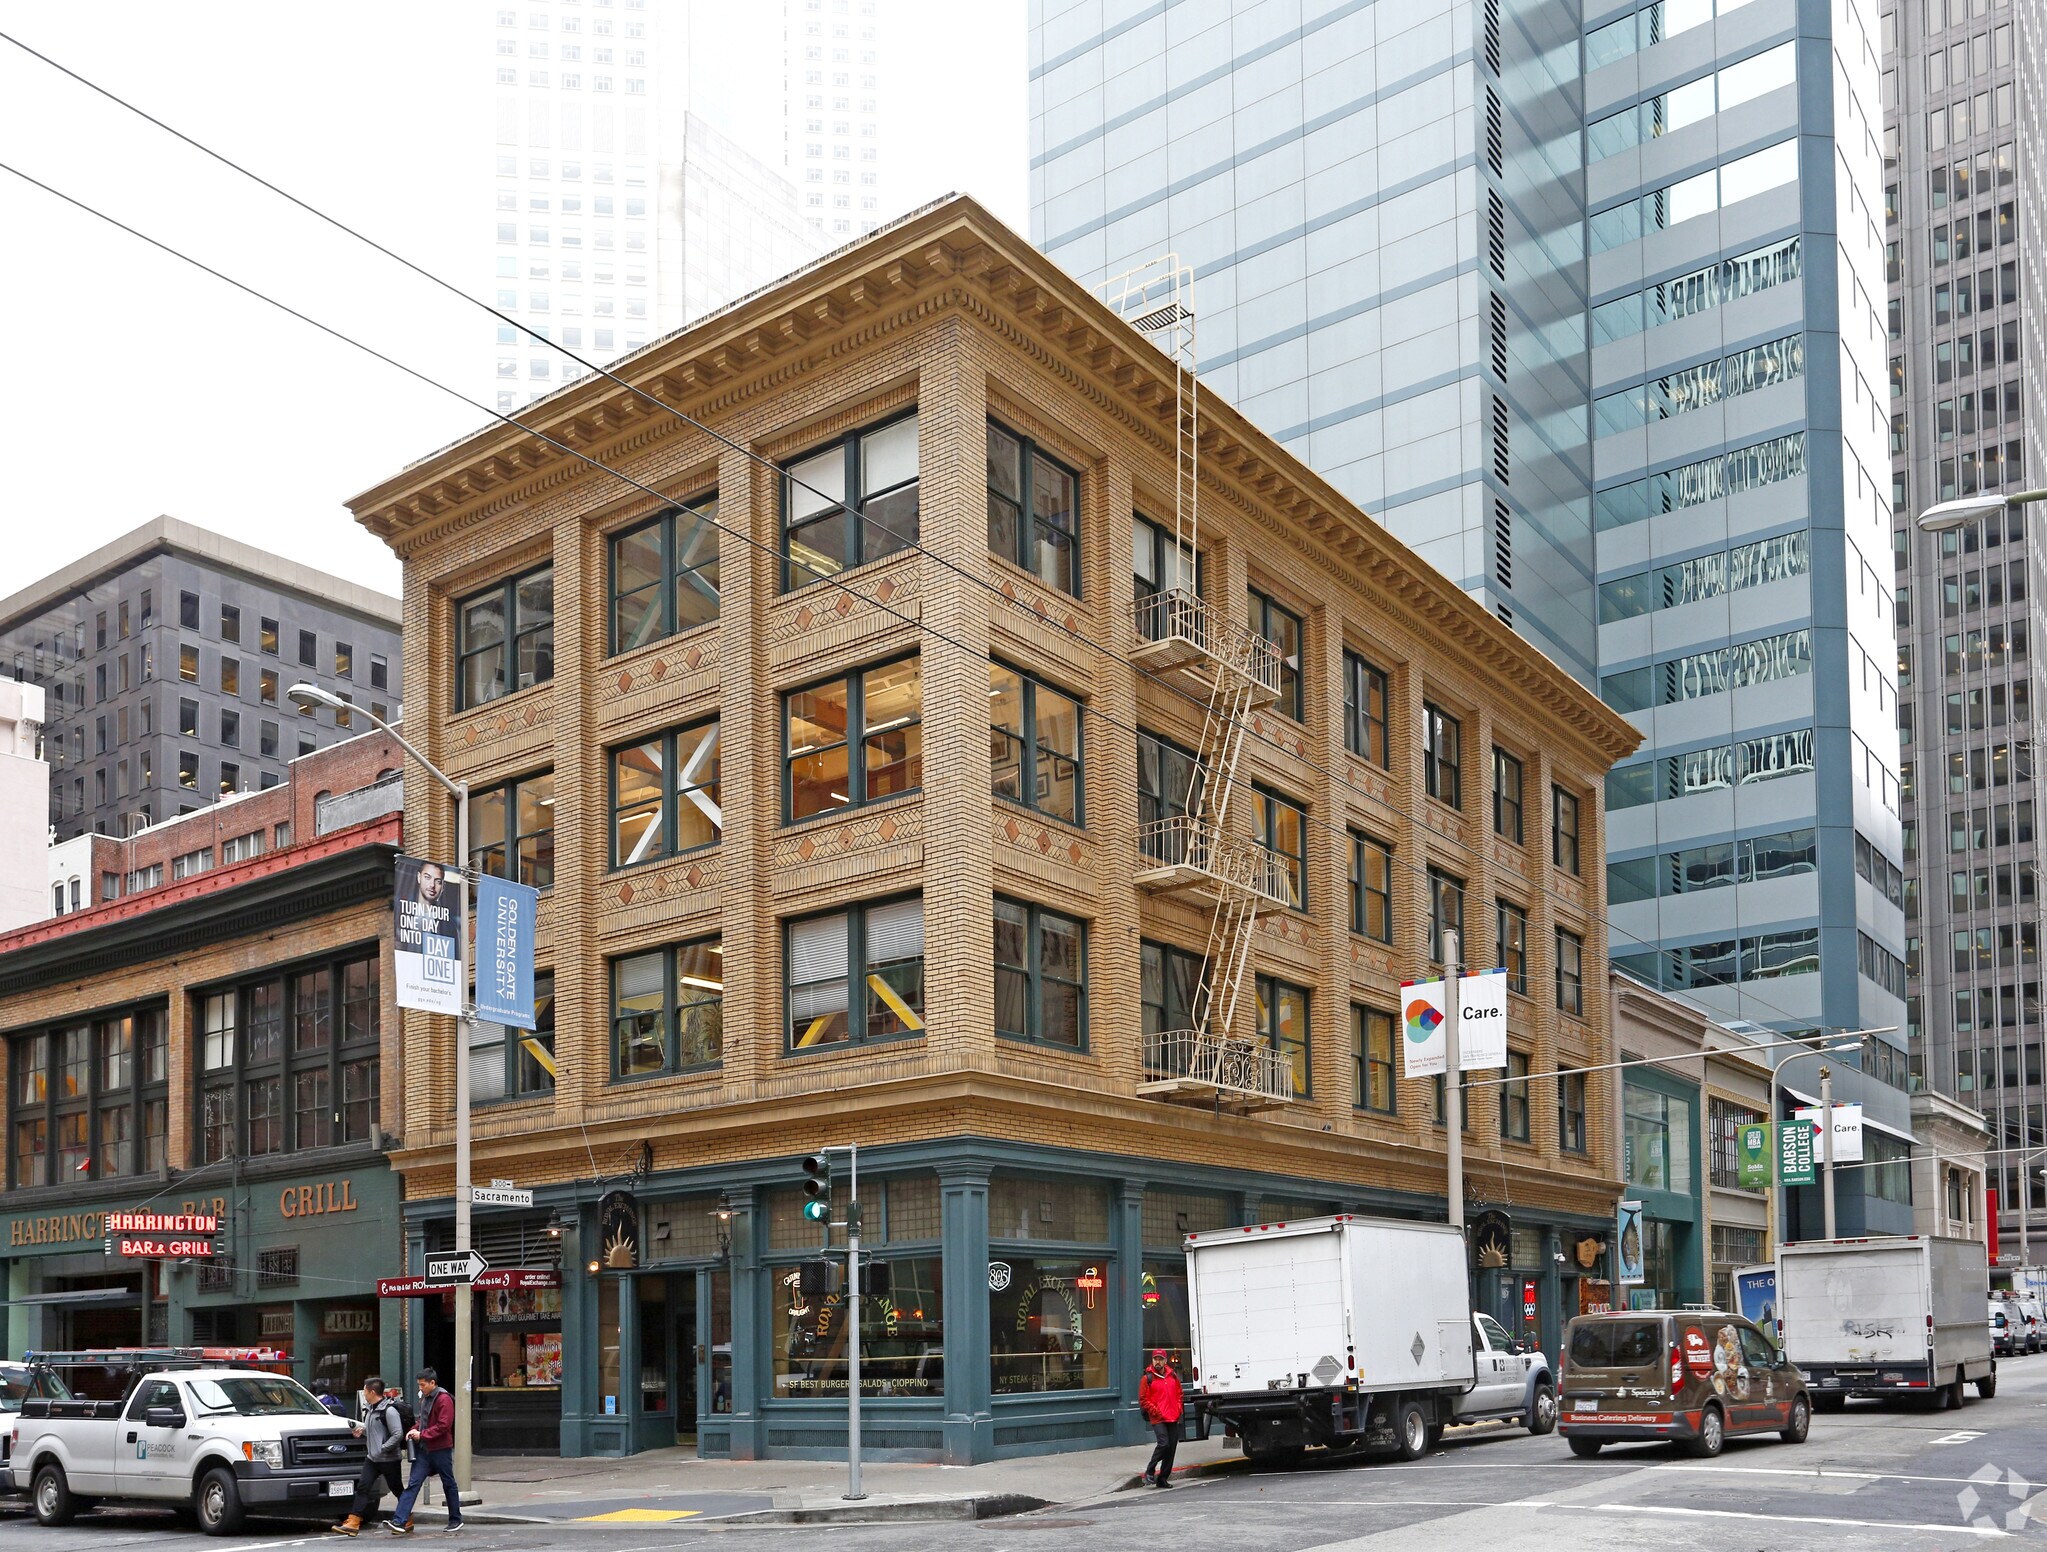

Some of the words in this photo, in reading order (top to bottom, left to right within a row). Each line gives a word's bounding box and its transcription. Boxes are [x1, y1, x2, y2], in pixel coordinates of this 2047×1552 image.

[400, 899, 426, 917] TURN
[426, 903, 450, 922] YOUR
[400, 914, 419, 931] ONE
[422, 917, 440, 934] DAY
[507, 898, 518, 959] GOLDEN
[400, 930, 422, 945] INTO
[426, 936, 450, 958] DAY
[496, 896, 508, 999] UNIVERSITY
[427, 958, 451, 979] ONE
[406, 982, 420, 991] Finish
[420, 986, 430, 994] your
[506, 961, 516, 1001] GATE
[1463, 1006, 1503, 1020] Care.
[1409, 1056, 1423, 1064] Newly
[1423, 1053, 1445, 1062] Expanded
[1409, 1063, 1421, 1071] Open
[1834, 1124, 1860, 1133] Care.
[1747, 1138, 1761, 1146] MBA
[1798, 1125, 1811, 1172] COLLEGE
[1783, 1126, 1797, 1174] BABSON
[494, 1180, 507, 1188] 300
[280, 1179, 358, 1218] GRILL
[474, 1190, 530, 1203] Sacramento
[109, 1213, 217, 1232] HARRINGTON
[121, 1240, 158, 1255] BAR
[157, 1242, 166, 1254] &
[168, 1240, 212, 1255] GRILL
[430, 1263, 448, 1275] ONE
[450, 1261, 469, 1274] WAY
[519, 1279, 557, 1287] RoyalExchange.com
[989, 1268, 1009, 1284] 805
[1747, 1279, 1765, 1289] THE
[1767, 1278, 1775, 1287] O
[788, 1304, 811, 1317] DRAUGHT
[1016, 1283, 1038, 1332] ROYAL
[334, 1312, 364, 1330] PUB
[488, 1314, 502, 1323] FRESH
[517, 1312, 539, 1322] GOURMET
[539, 1311, 550, 1320] TAKE
[550, 1311, 561, 1320] AWA
[527, 1341, 559, 1353] sandwich
[788, 1380, 799, 1389] SF
[800, 1380, 819, 1389] BEST
[891, 1378, 929, 1388] CIOPPINO
[999, 1375, 1008, 1385] NY
[1009, 1374, 1028, 1384] STEAK
[1631, 1388, 1665, 1397] Specialty's
[1598, 1414, 1627, 1422] Catering
[1627, 1414, 1657, 1423] Delivery
[147, 1443, 176, 1453] PEACOCK
